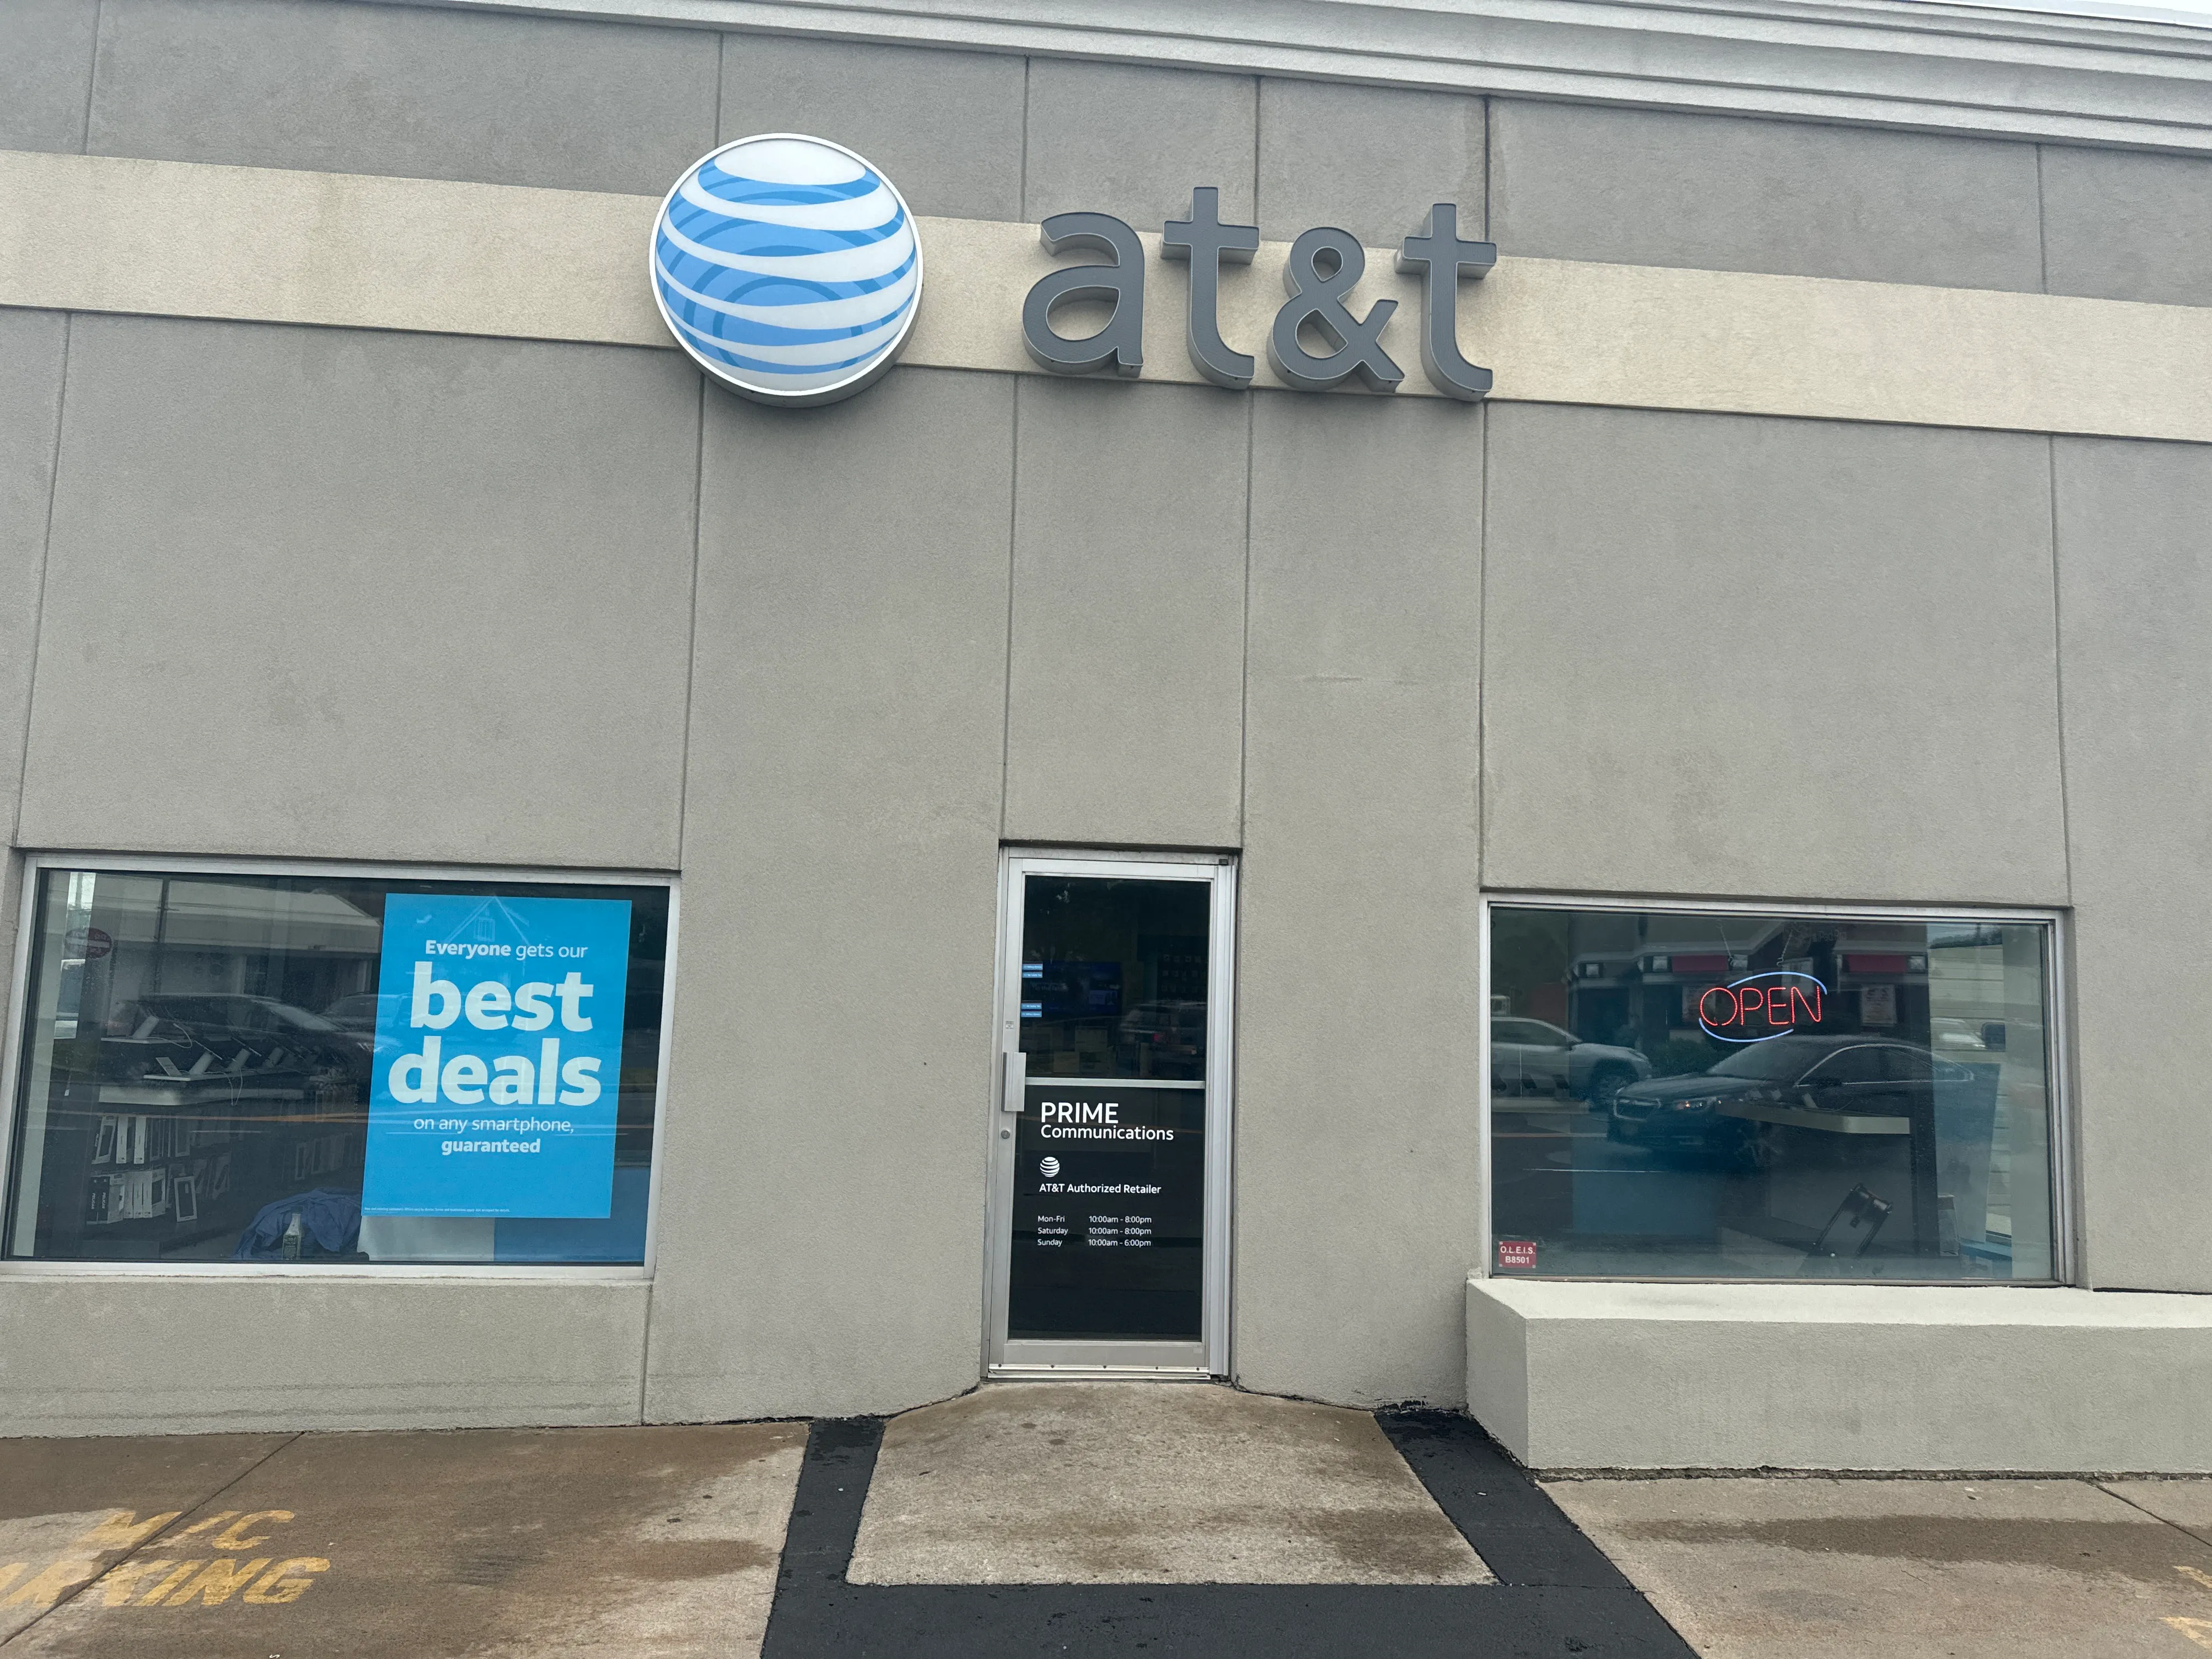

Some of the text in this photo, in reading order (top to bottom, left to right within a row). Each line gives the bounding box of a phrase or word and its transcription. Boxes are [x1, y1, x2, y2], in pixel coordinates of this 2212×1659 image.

[1022, 187, 1497, 398] at&t
[425, 940, 588, 961] Everyone gets our
[410, 961, 594, 1032] best
[1700, 986, 1822, 1026] OPEN
[388, 1036, 602, 1106] deals
[1041, 1102, 1119, 1124] PRIME
[414, 1117, 574, 1135] on any smartphone,
[1041, 1125, 1174, 1141] Communications
[441, 1138, 541, 1156] guaranteed
[1039, 1183, 1161, 1194] AT&T Authorized Retailer
[1125, 1216, 1152, 1224] 8:00pm
[1037, 1227, 1068, 1235] Saturday
[1125, 1228, 1152, 1236] 8:00pm
[1037, 1239, 1063, 1247] Sunday
[1124, 1239, 1152, 1248] 6:00pm
[1505, 1256, 1530, 1264] B8501
